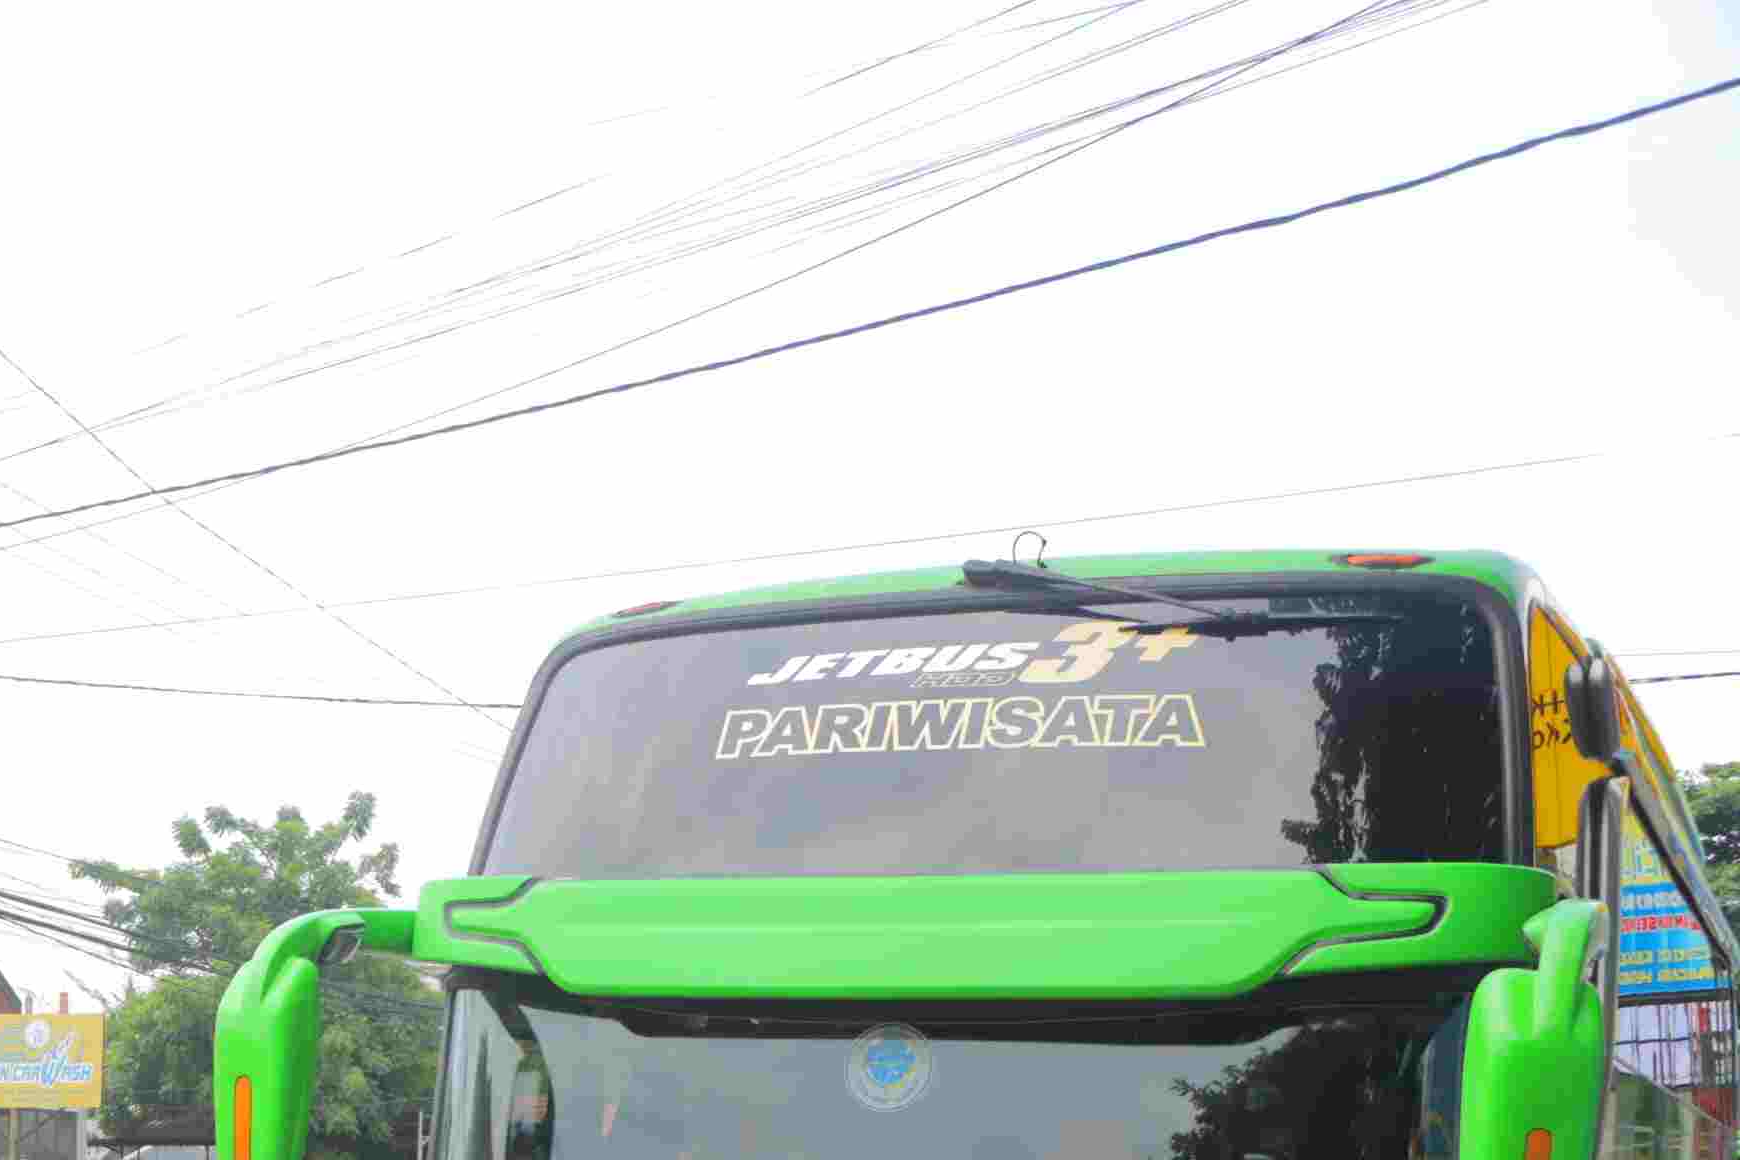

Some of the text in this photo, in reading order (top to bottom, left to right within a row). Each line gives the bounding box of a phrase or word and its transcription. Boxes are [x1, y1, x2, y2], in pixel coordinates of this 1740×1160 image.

[747, 619, 1200, 686] JETBUS 3+
[715, 691, 1206, 760] PARIWISATA
